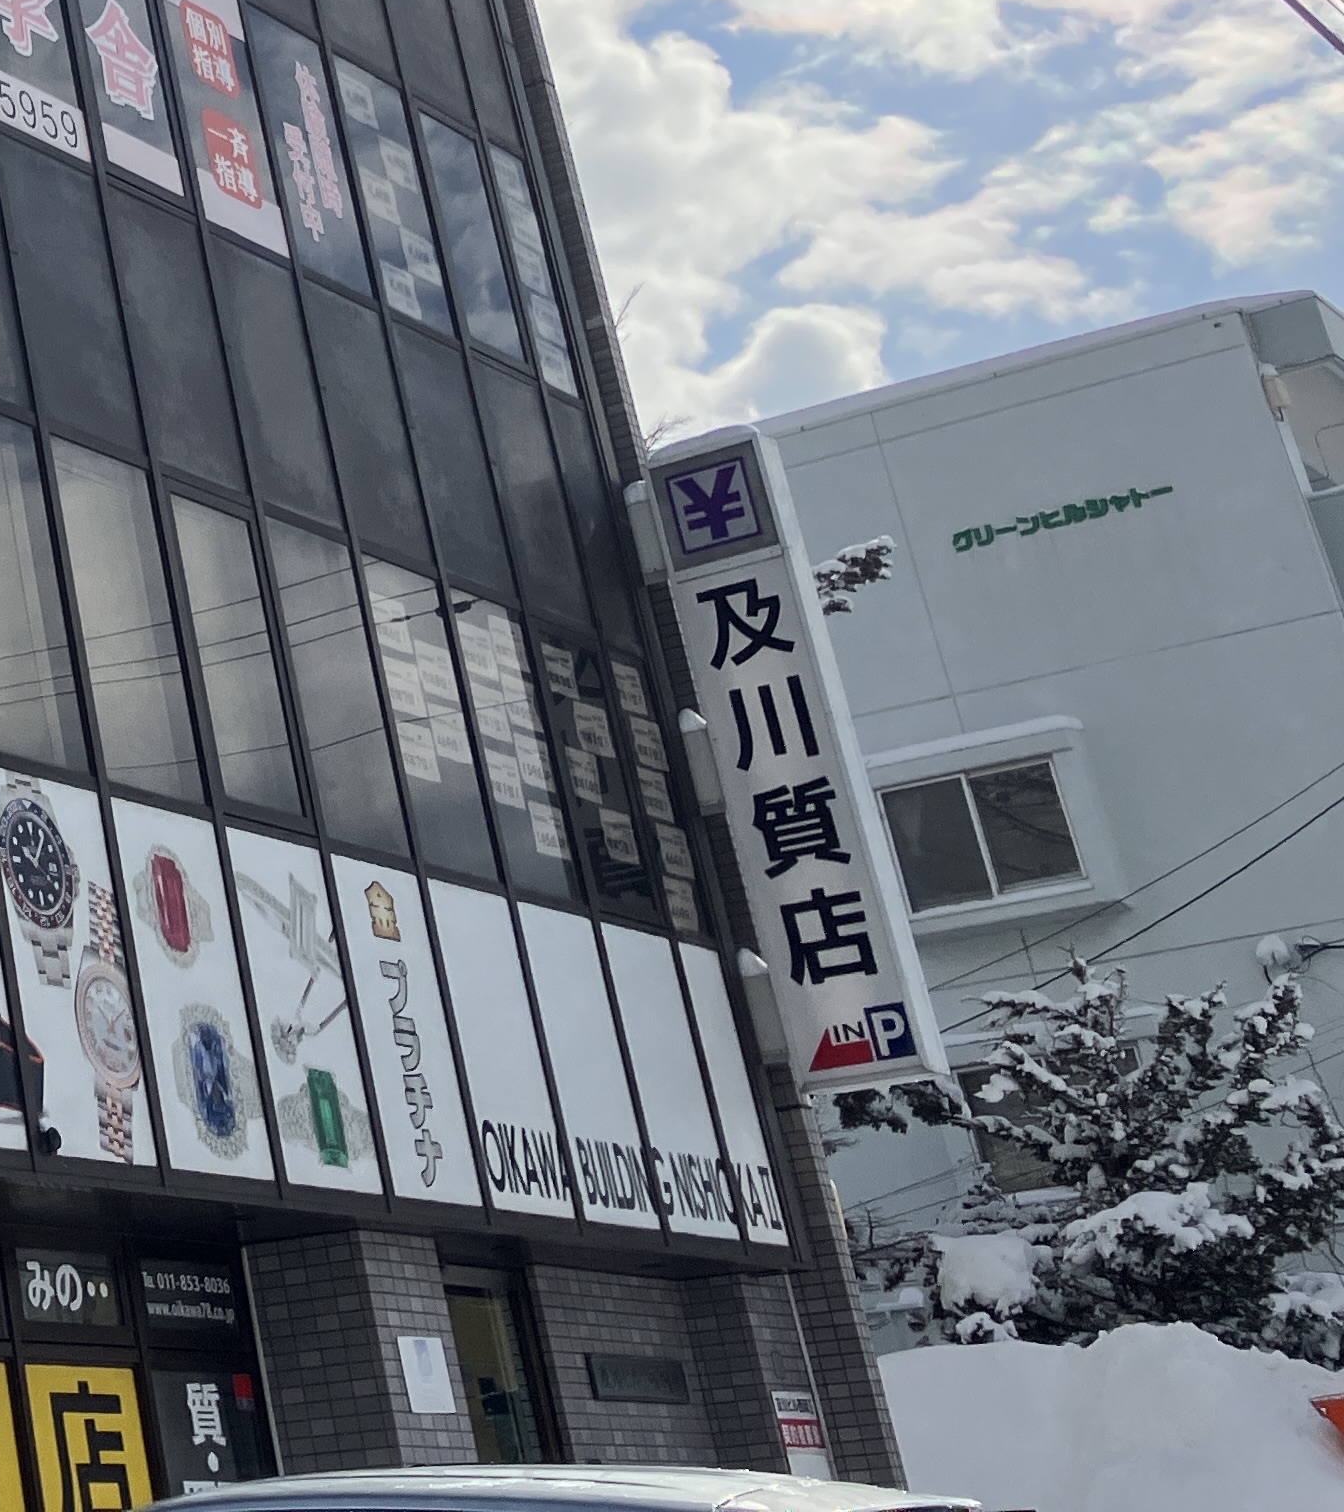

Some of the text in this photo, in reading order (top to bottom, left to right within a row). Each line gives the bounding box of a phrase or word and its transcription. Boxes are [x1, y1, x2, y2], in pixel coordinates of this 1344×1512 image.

[952, 486, 1173, 553] グリーンヒルシャトー
[696, 578, 878, 986] 及川質店
[832, 1010, 905, 1056] IN P
[482, 1119, 574, 1202] OIKAWA
[575, 1136, 674, 1217] BUILDING
